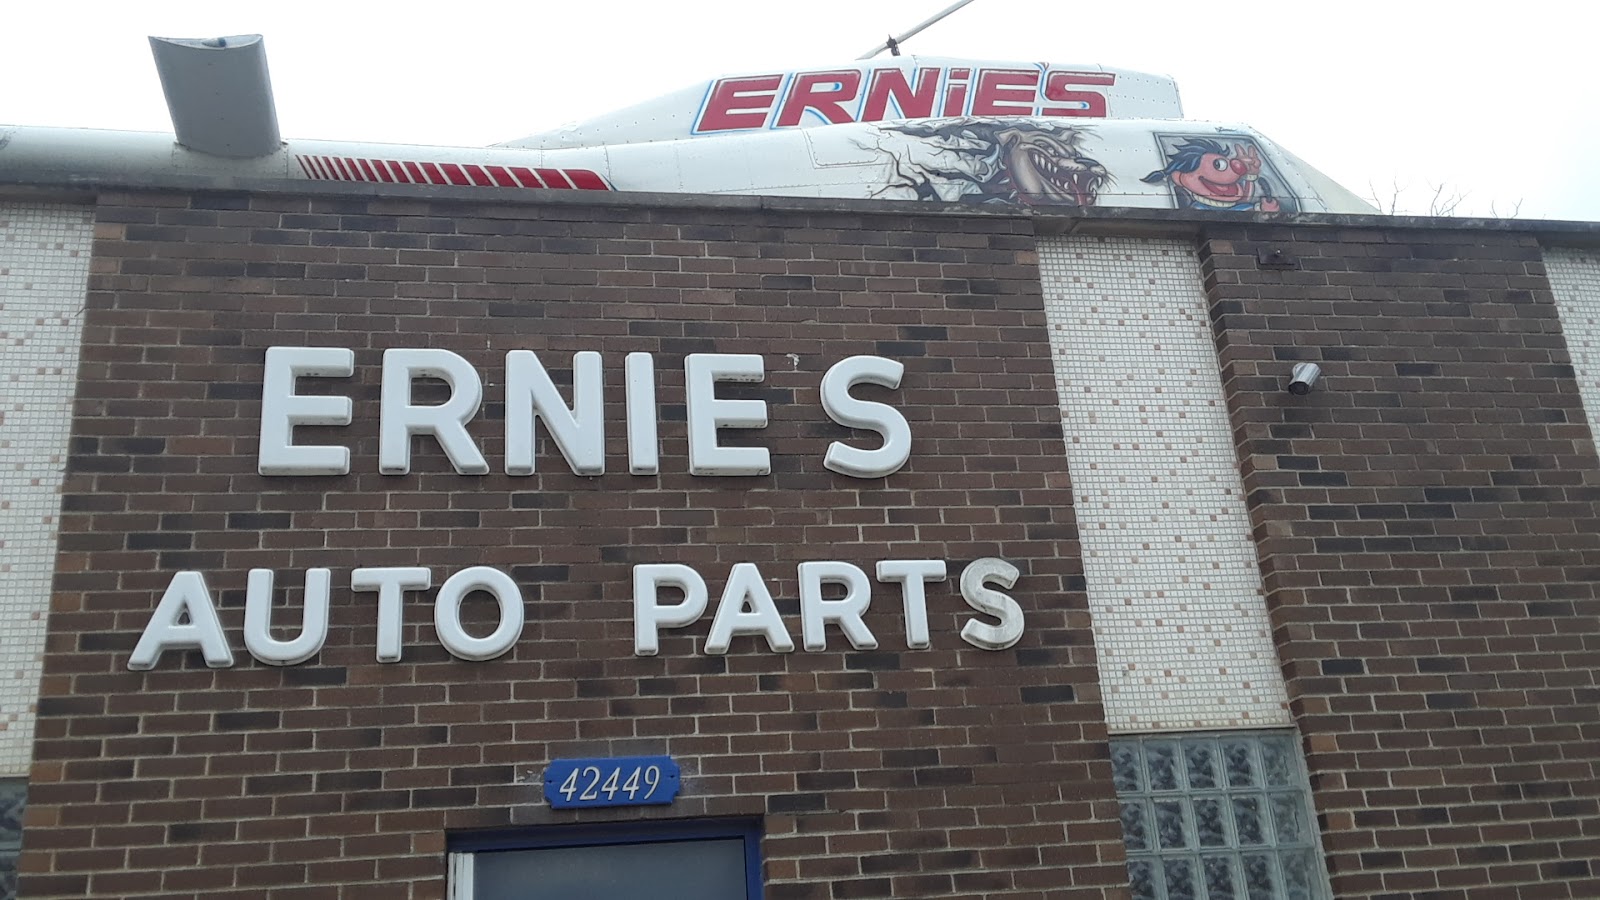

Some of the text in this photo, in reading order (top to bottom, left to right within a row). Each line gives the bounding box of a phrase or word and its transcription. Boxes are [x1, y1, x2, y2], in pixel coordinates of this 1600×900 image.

[126, 557, 1026, 671] AUTO PARTS
[559, 765, 661, 802] 42449
